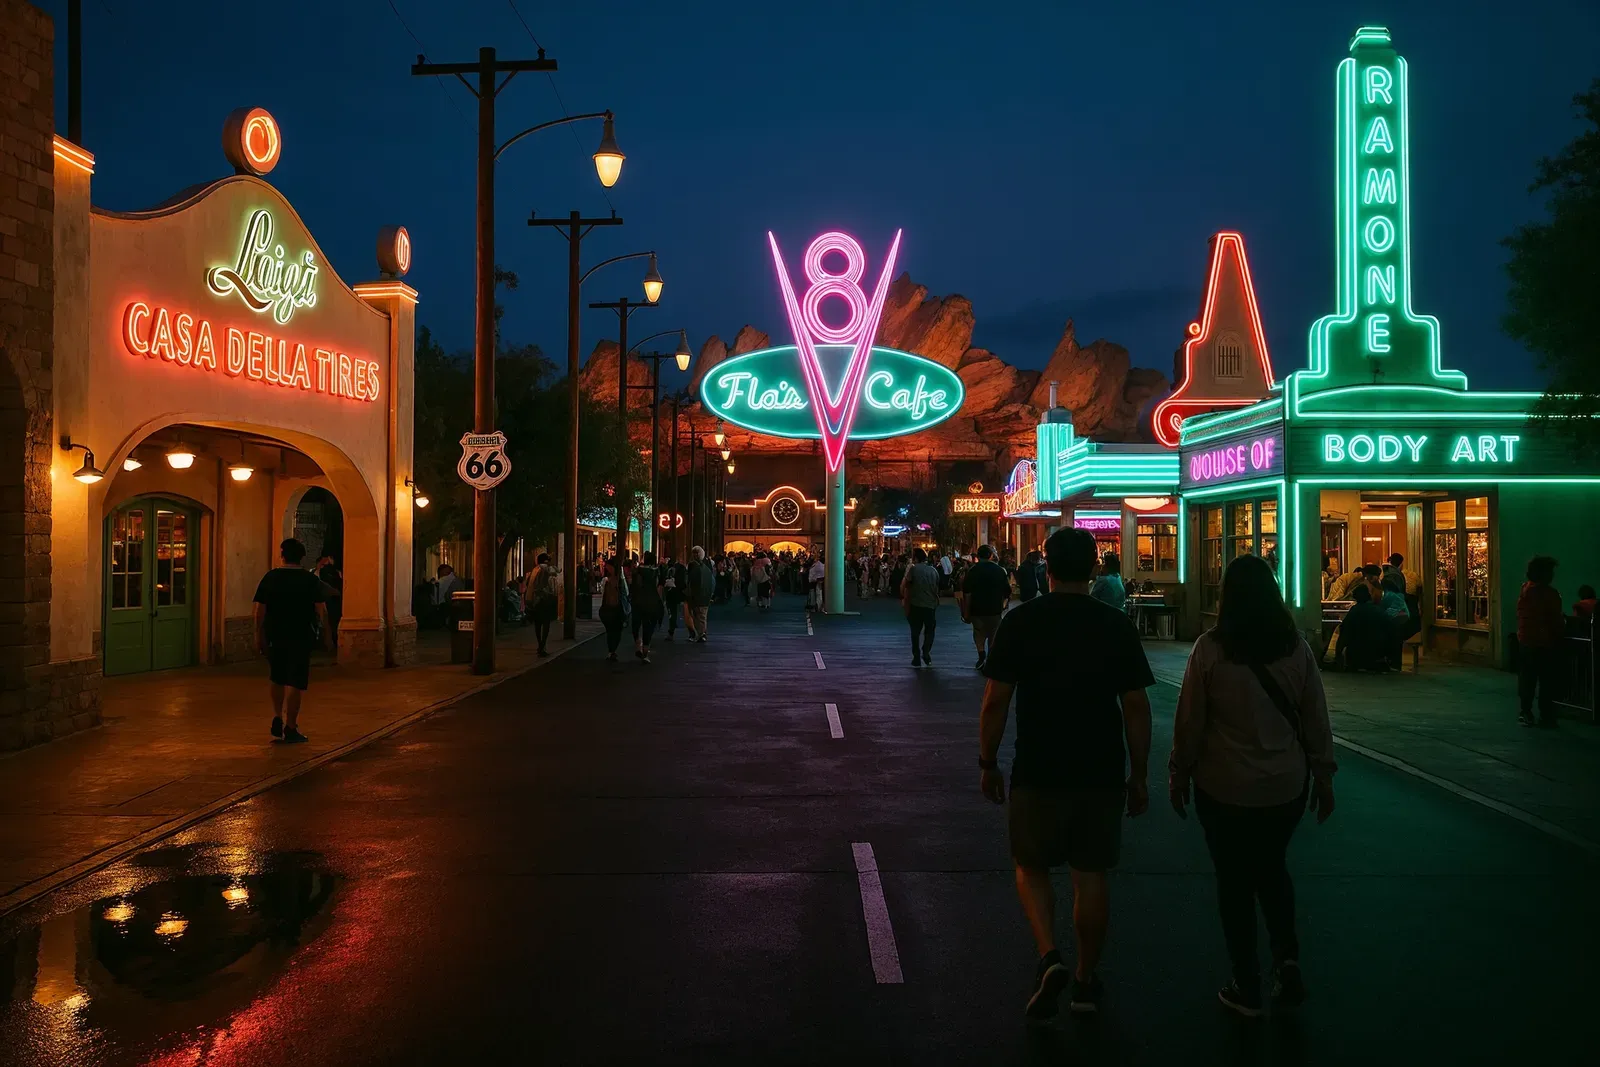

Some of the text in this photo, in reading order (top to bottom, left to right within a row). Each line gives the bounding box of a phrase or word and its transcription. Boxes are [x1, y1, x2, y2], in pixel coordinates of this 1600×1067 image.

[1363, 65, 1397, 354] RAMONE
[123, 302, 381, 402] CASA DELLA TIRES
[864, 371, 949, 420] Cafe
[466, 451, 504, 479] 66
[1250, 438, 1275, 470] OF
[1323, 434, 1520, 463] BODY ART
